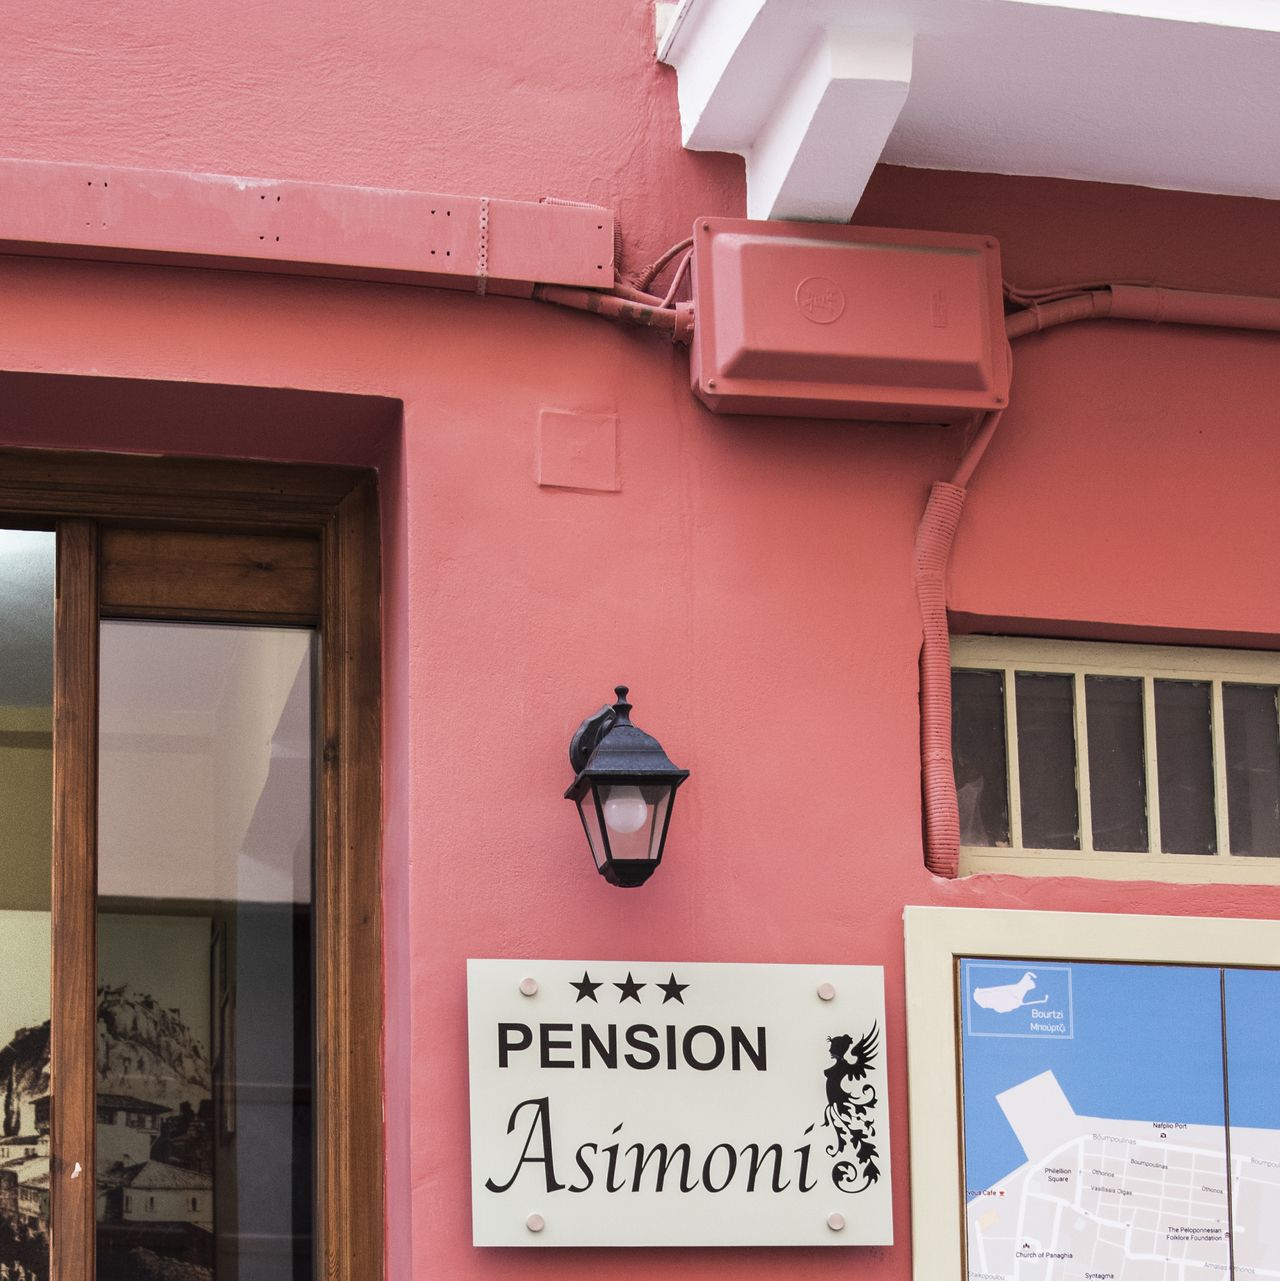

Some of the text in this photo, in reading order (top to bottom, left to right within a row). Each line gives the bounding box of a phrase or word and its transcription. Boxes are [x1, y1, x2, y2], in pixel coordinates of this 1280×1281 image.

[1031, 1009, 1063, 1019] Bourtzi
[497, 1022, 767, 1072] PENSION
[1152, 1122, 1174, 1130] Nafplio
[1092, 1133, 1137, 1145] Boumpoulinas
[485, 1096, 818, 1194] Asimoni
[1130, 1158, 1169, 1170] Boumpoulinas
[1091, 1168, 1115, 1178] Othonos
[1048, 1175, 1069, 1183] Square
[1201, 1185, 1224, 1195] Othonos
[1179, 1226, 1222, 1234] Peloponnesian
[1045, 1252, 1073, 1260] Panaghia
[1084, 1272, 1114, 1280] Syntagma
